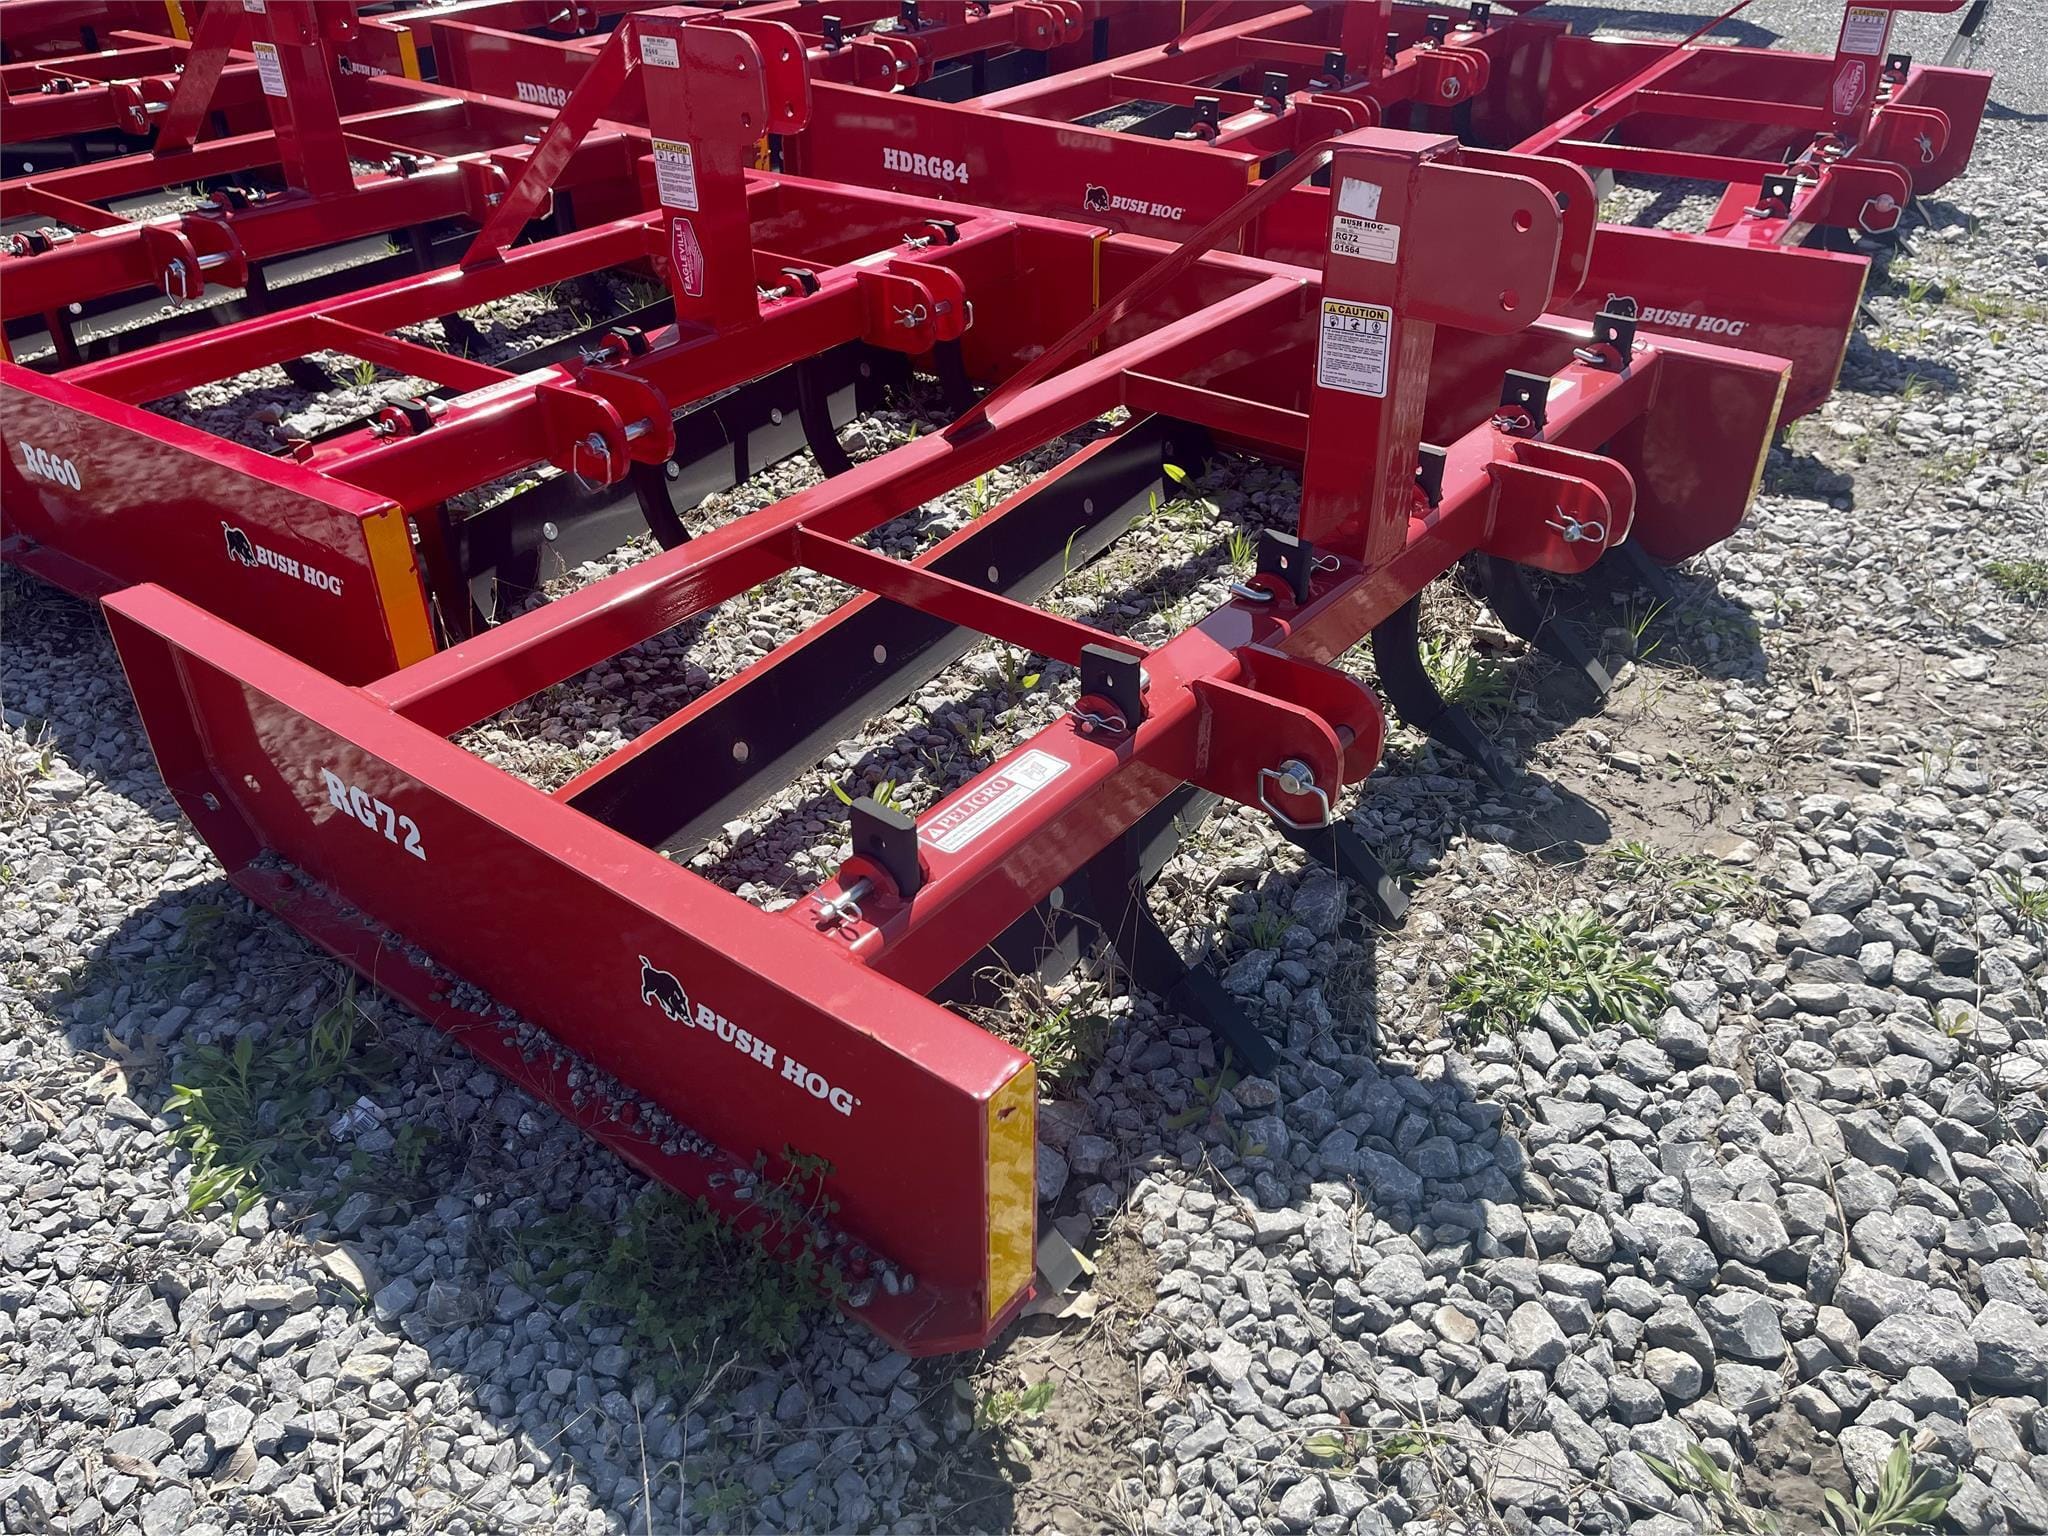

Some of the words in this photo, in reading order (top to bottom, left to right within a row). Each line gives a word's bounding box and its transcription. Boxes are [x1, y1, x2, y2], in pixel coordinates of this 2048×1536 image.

[352, 62, 370, 76] BUSH
[515, 81, 573, 107] HDRG8
[883, 147, 969, 184] HDRG84
[1110, 195, 1149, 214] BUSH
[1149, 203, 1183, 220] HOG
[1335, 231, 1358, 243] RG72
[1340, 218, 1362, 227] BUSH
[1364, 221, 1384, 231] HOG
[674, 224, 692, 290] EAGLEVILLE
[1334, 243, 1360, 255] 01564
[1338, 305, 1384, 320] CAUTION
[1639, 307, 1696, 328] BUSH
[1695, 316, 1745, 336] HOG
[19, 440, 81, 491] RG60
[255, 544, 300, 579] BUSH
[302, 564, 342, 597] HOG
[321, 766, 427, 861] RG72
[940, 778, 1009, 830] PELIGRO
[695, 1002, 776, 1069] BUSH
[780, 1055, 854, 1117] HOG
